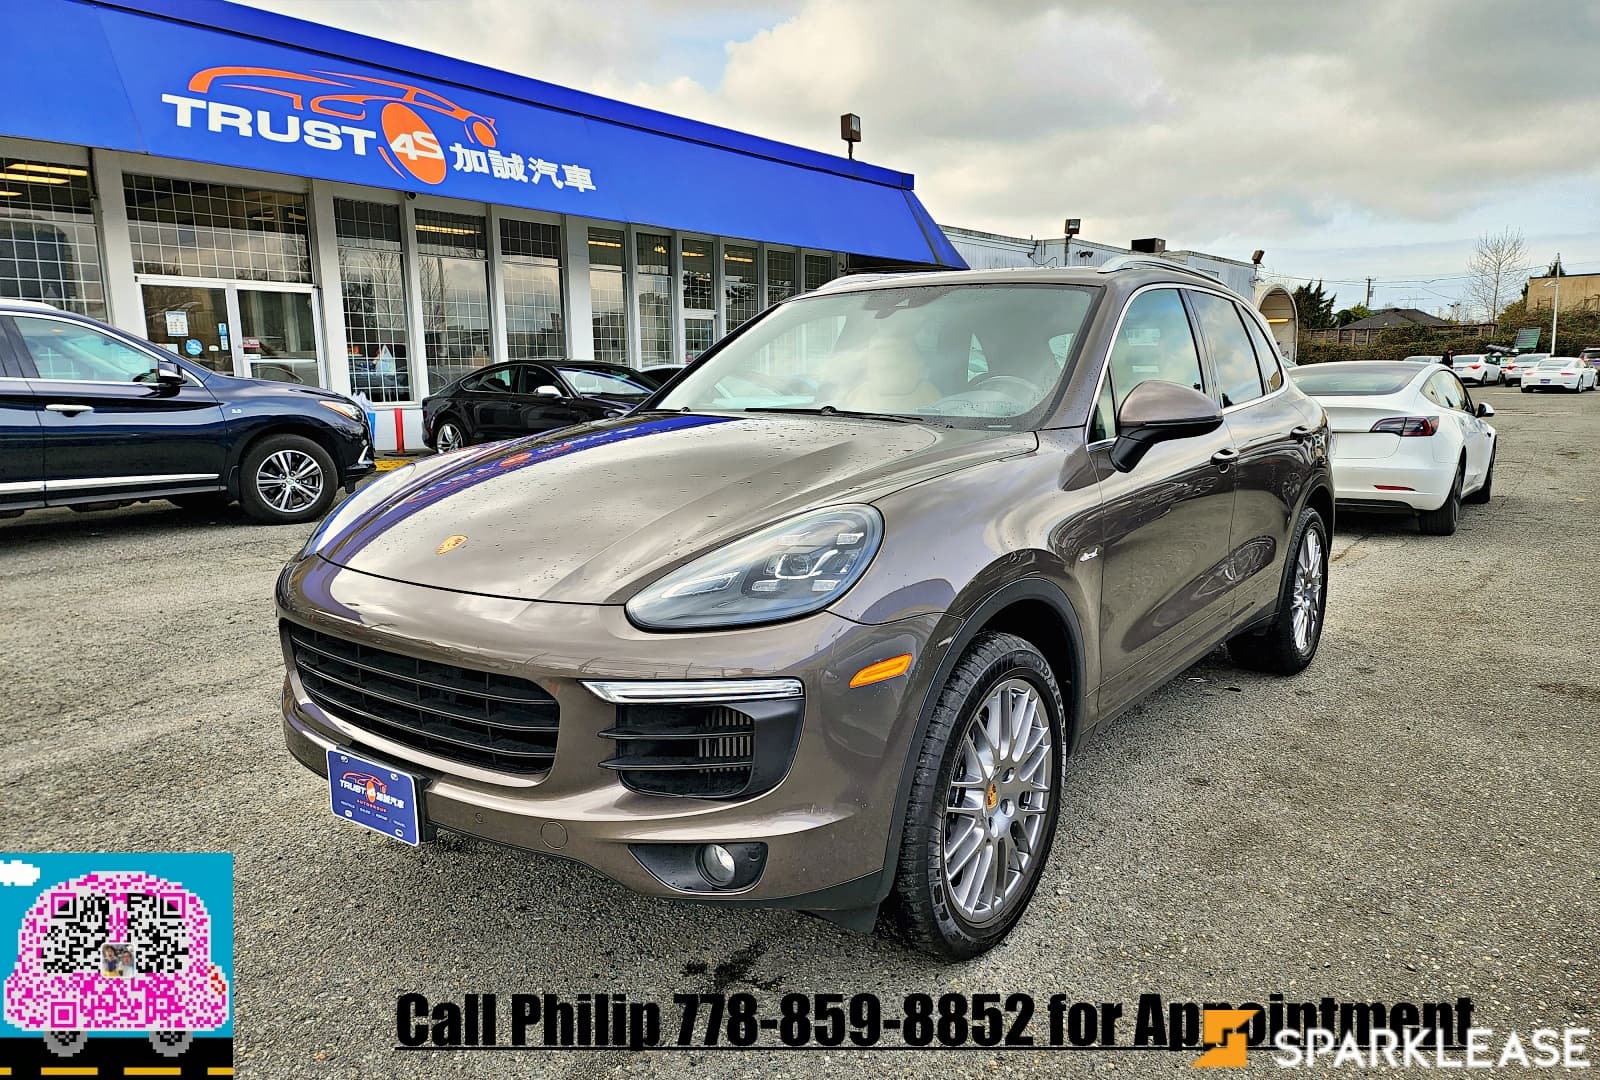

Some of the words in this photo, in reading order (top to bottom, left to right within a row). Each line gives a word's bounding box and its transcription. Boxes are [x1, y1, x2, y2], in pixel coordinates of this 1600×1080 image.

[162, 93, 377, 157] TRUST
[390, 130, 444, 161] 4S
[449, 142, 597, 193] 加誠汽車
[340, 779, 366, 795] TRUST
